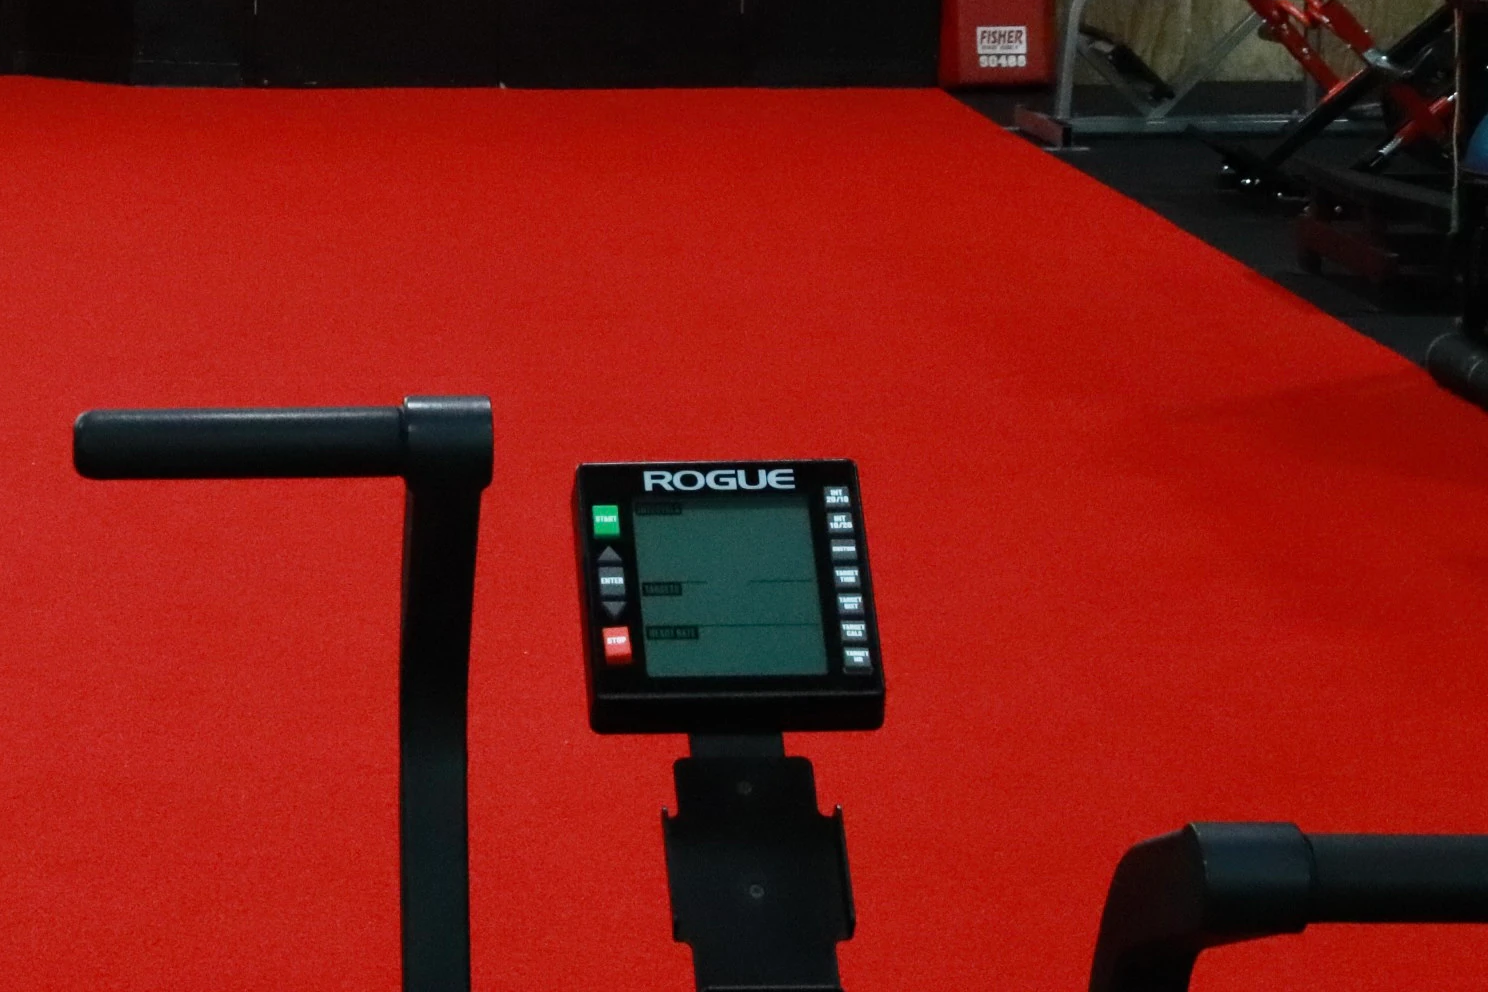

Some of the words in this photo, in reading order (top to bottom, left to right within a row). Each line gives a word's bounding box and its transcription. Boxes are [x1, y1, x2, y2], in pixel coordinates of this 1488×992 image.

[980, 29, 1023, 45] FISHER
[643, 468, 796, 492] ROGUE
[600, 576, 624, 584] ENTER
